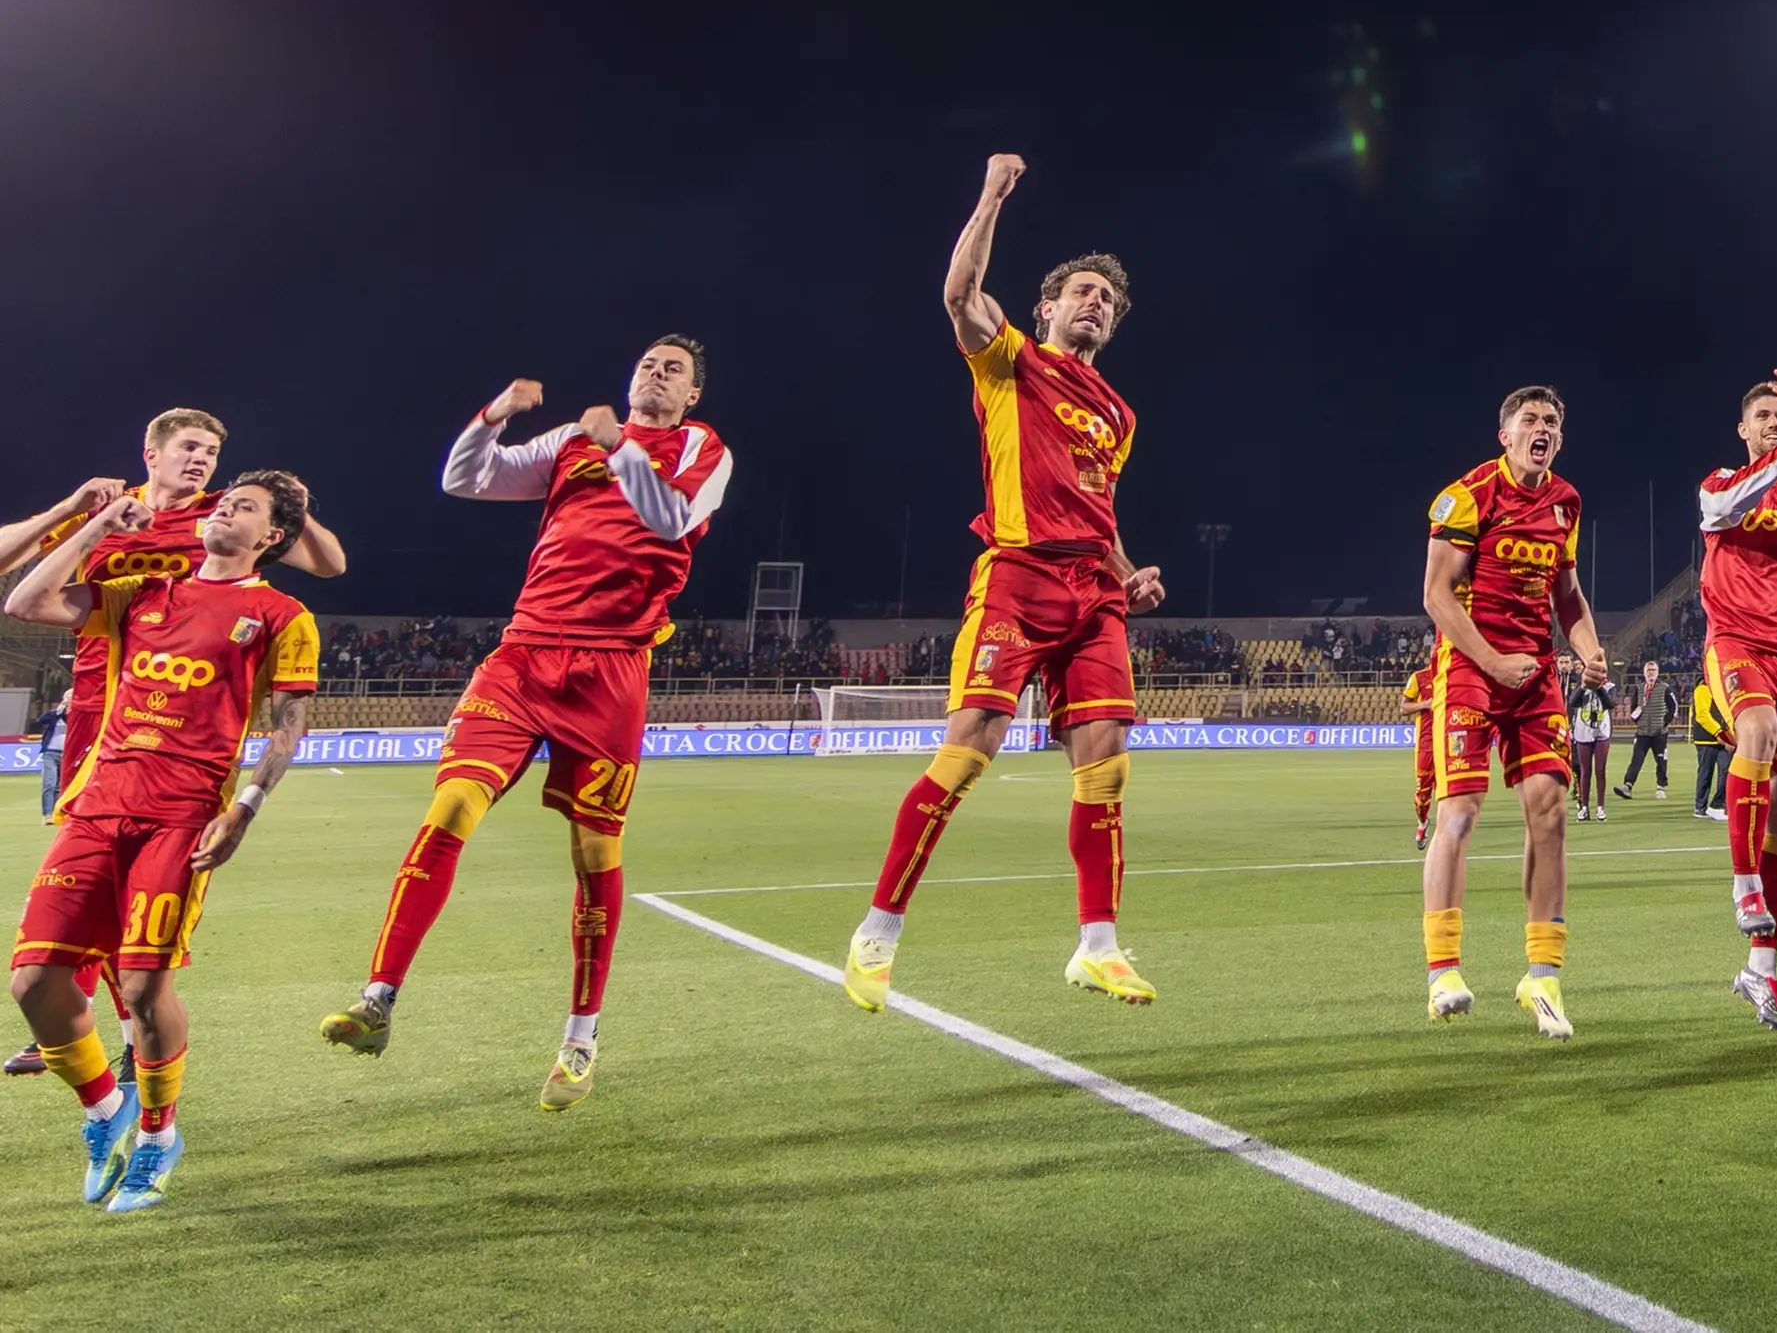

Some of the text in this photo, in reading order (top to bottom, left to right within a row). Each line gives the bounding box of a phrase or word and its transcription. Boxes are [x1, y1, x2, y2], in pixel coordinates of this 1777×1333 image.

[1054, 402, 1116, 448] coop
[1496, 537, 1557, 567] coop
[131, 650, 215, 692] coop
[123, 706, 184, 729] Bencivenni
[642, 733, 696, 752] NTA
[704, 732, 805, 752] CROCE
[830, 730, 924, 748] OFFICIAL
[1129, 727, 1211, 746] SANTA
[1218, 727, 1300, 746] CROCE
[1318, 727, 1398, 746] OFFICIAL
[577, 758, 636, 811] 20
[123, 890, 181, 946] 30
